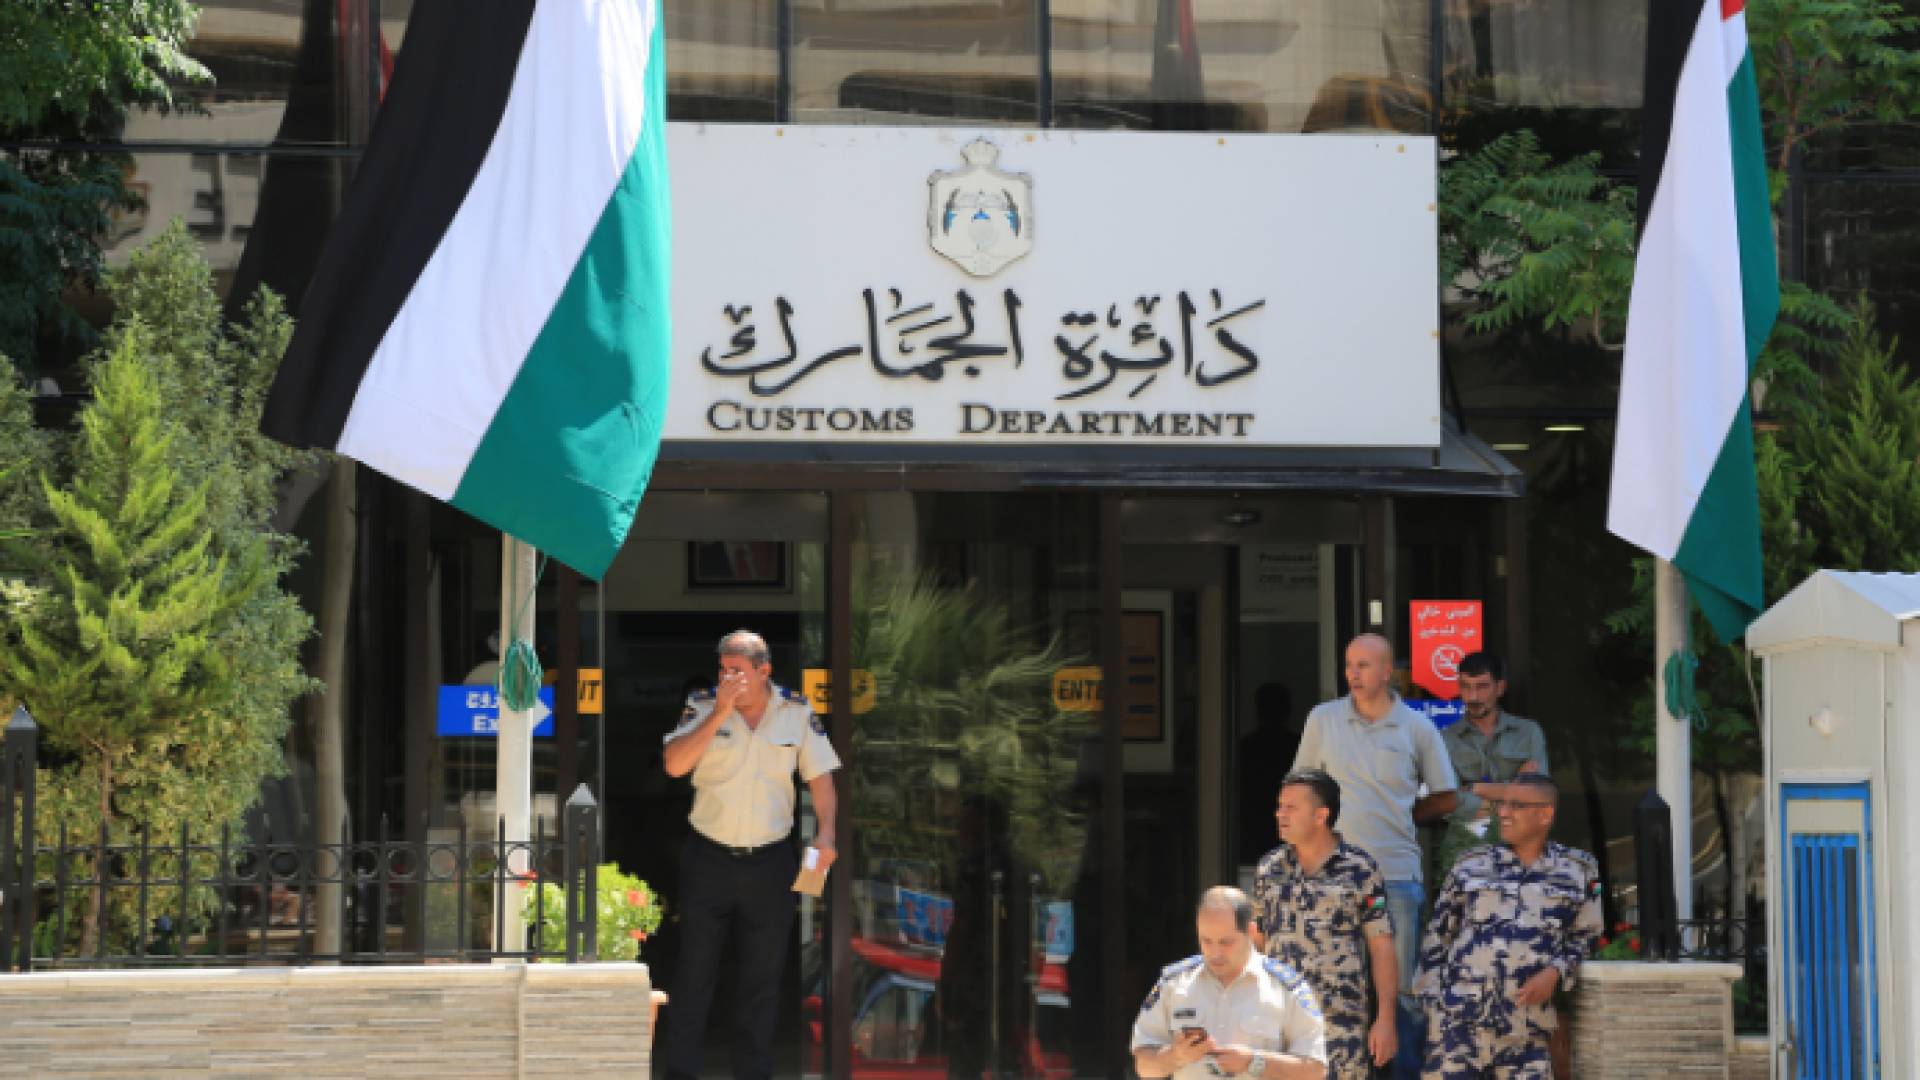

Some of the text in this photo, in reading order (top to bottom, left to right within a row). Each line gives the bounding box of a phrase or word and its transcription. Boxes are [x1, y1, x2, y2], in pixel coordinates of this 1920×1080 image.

[701, 287, 1266, 400] دائرة الجمارك
[706, 400, 1255, 437] CUSTOMS DEPARTMENT
